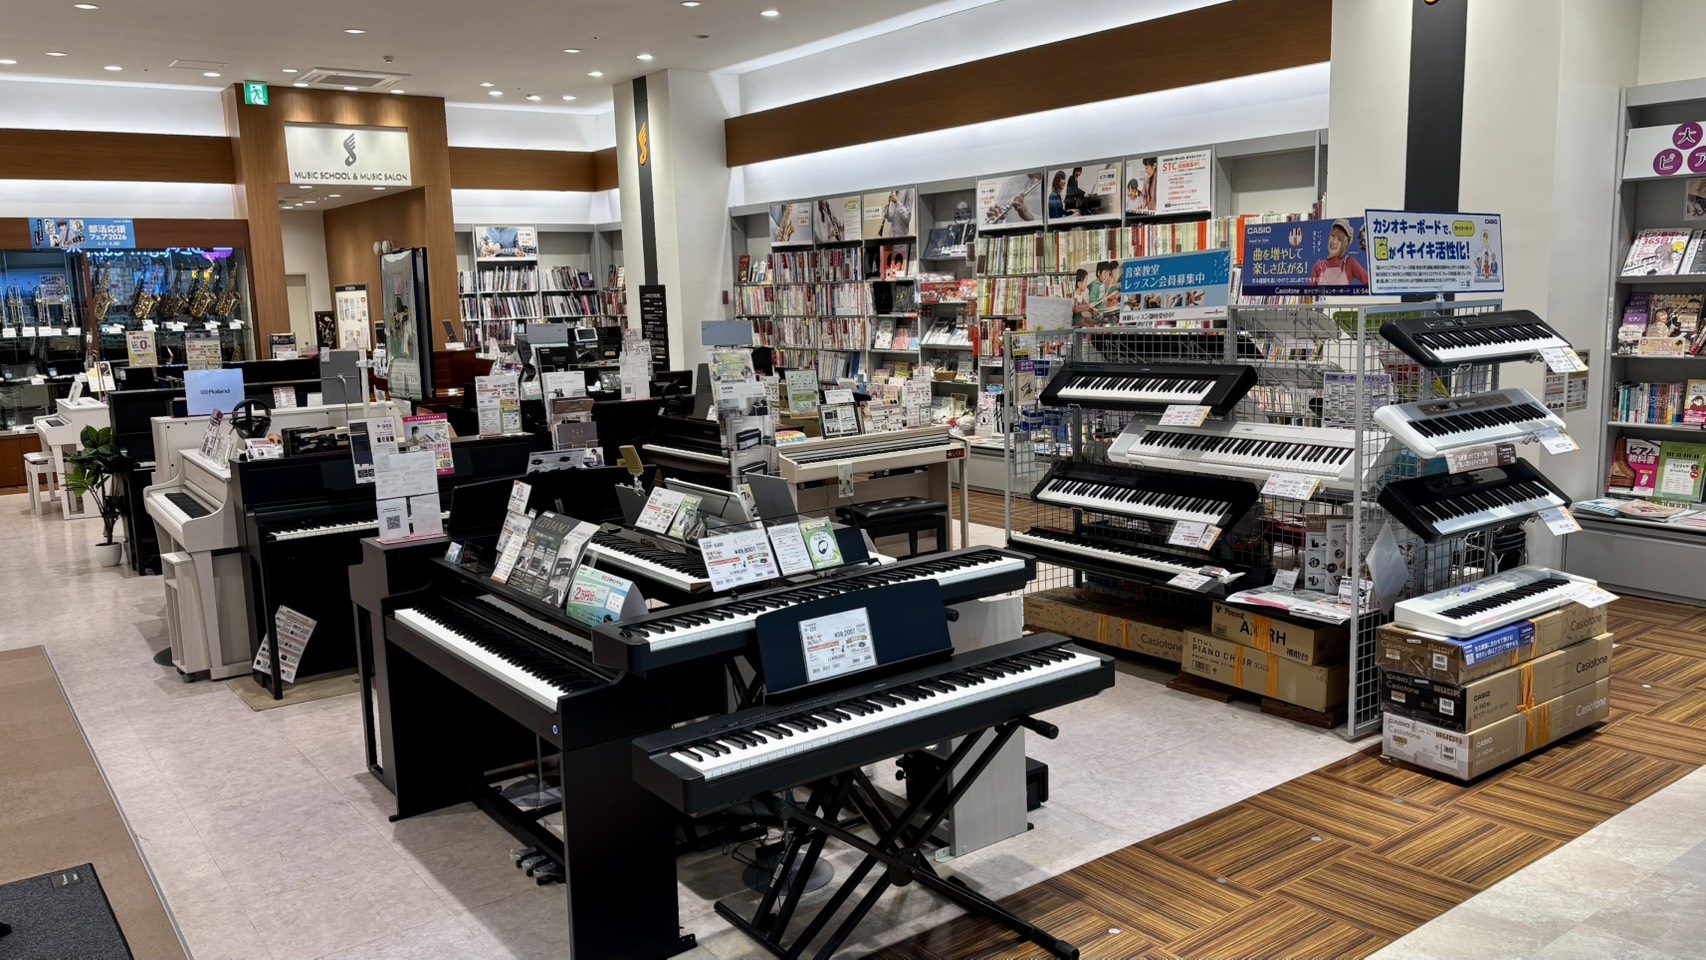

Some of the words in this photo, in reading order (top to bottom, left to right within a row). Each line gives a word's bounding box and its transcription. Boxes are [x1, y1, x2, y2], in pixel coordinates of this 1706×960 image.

[1677, 126, 1697, 145] 大
[1162, 162, 1177, 172] STC
[294, 171, 319, 180] MUSIC
[320, 172, 351, 180] SCHOOL
[360, 173, 383, 181] MUSIC
[384, 173, 408, 181] SALON
[88, 224, 127, 234] 部活応援
[1247, 226, 1272, 235] CASIO
[1373, 218, 1452, 235] カシオキーボードで、
[1643, 237, 1674, 246] 365日!
[1252, 247, 1304, 262] 曲を増やして
[1125, 264, 1161, 279] 音楽教室
[1252, 261, 1308, 275] 楽しさ広がる!
[1124, 272, 1206, 290] レッスン会員募集中
[1274, 287, 1300, 295] Casiotone
[1628, 454, 1656, 465] 教科書
[1570, 613, 1603, 632] Casiotone
[1140, 633, 1183, 653] Casiotone
[1192, 643, 1221, 658] PIANO
[1286, 647, 1309, 662] 補助台
[1576, 654, 1609, 674] Casiotone
[1386, 680, 1420, 695] Casiotone
[1473, 690, 1491, 702] CASIO
[1576, 697, 1607, 717] Casiotone
[1388, 718, 1411, 729] CASIO
[1387, 725, 1422, 741] Casiotone
[1476, 736, 1493, 749] CASIO
